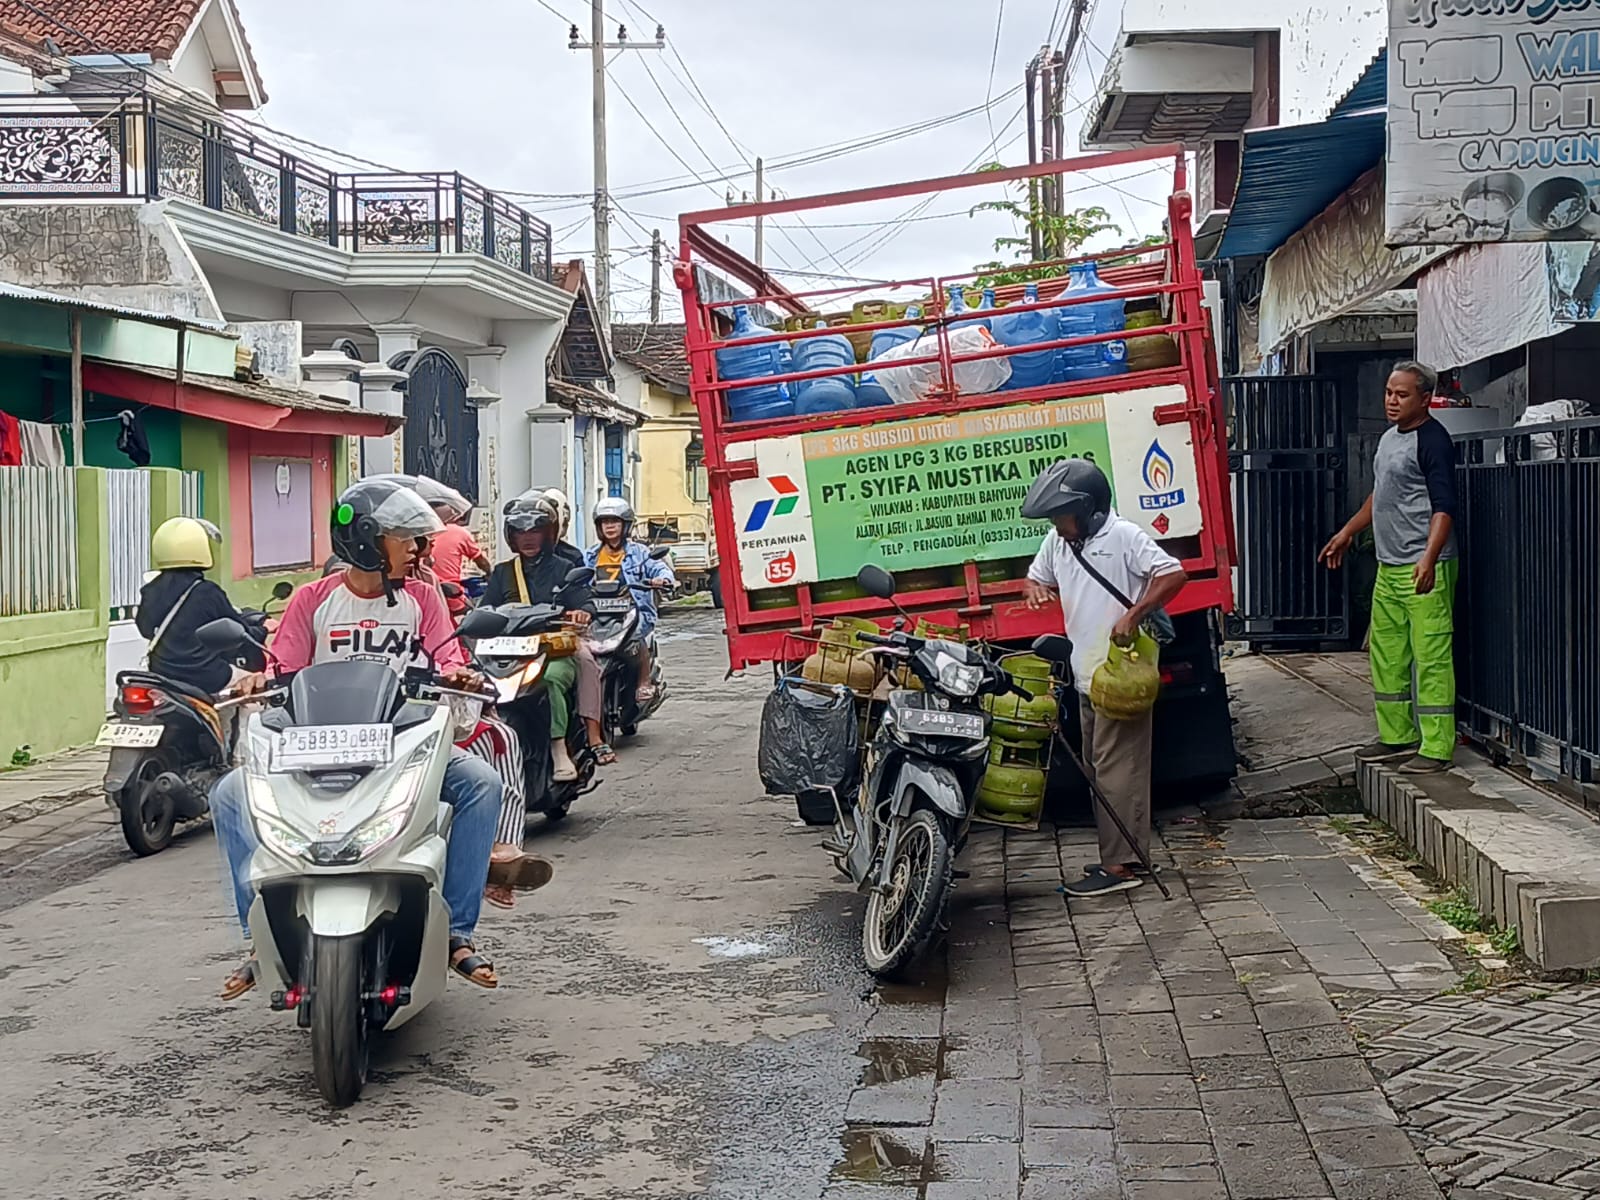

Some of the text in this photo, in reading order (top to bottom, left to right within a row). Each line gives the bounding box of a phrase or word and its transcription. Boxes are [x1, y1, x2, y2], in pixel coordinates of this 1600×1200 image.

[832, 434, 858, 452] 3KG
[863, 426, 914, 449] SUBSIDI
[1055, 401, 1104, 423] MISKIN
[846, 432, 1068, 476] AGEN LPG 3 KG BERSUBSIDI
[822, 483, 855, 503] PT.
[861, 474, 921, 499] SYIFA
[926, 461, 1022, 491] MUSTIKA
[870, 500, 913, 518] WILAYAH
[921, 491, 976, 511] KABUPATEN
[979, 485, 1031, 504] BANYUWA
[741, 534, 807, 550] PERTAMINA
[767, 561, 793, 579] 135
[330, 629, 403, 656] FILA
[904, 710, 981, 727] P 6385 ZF
